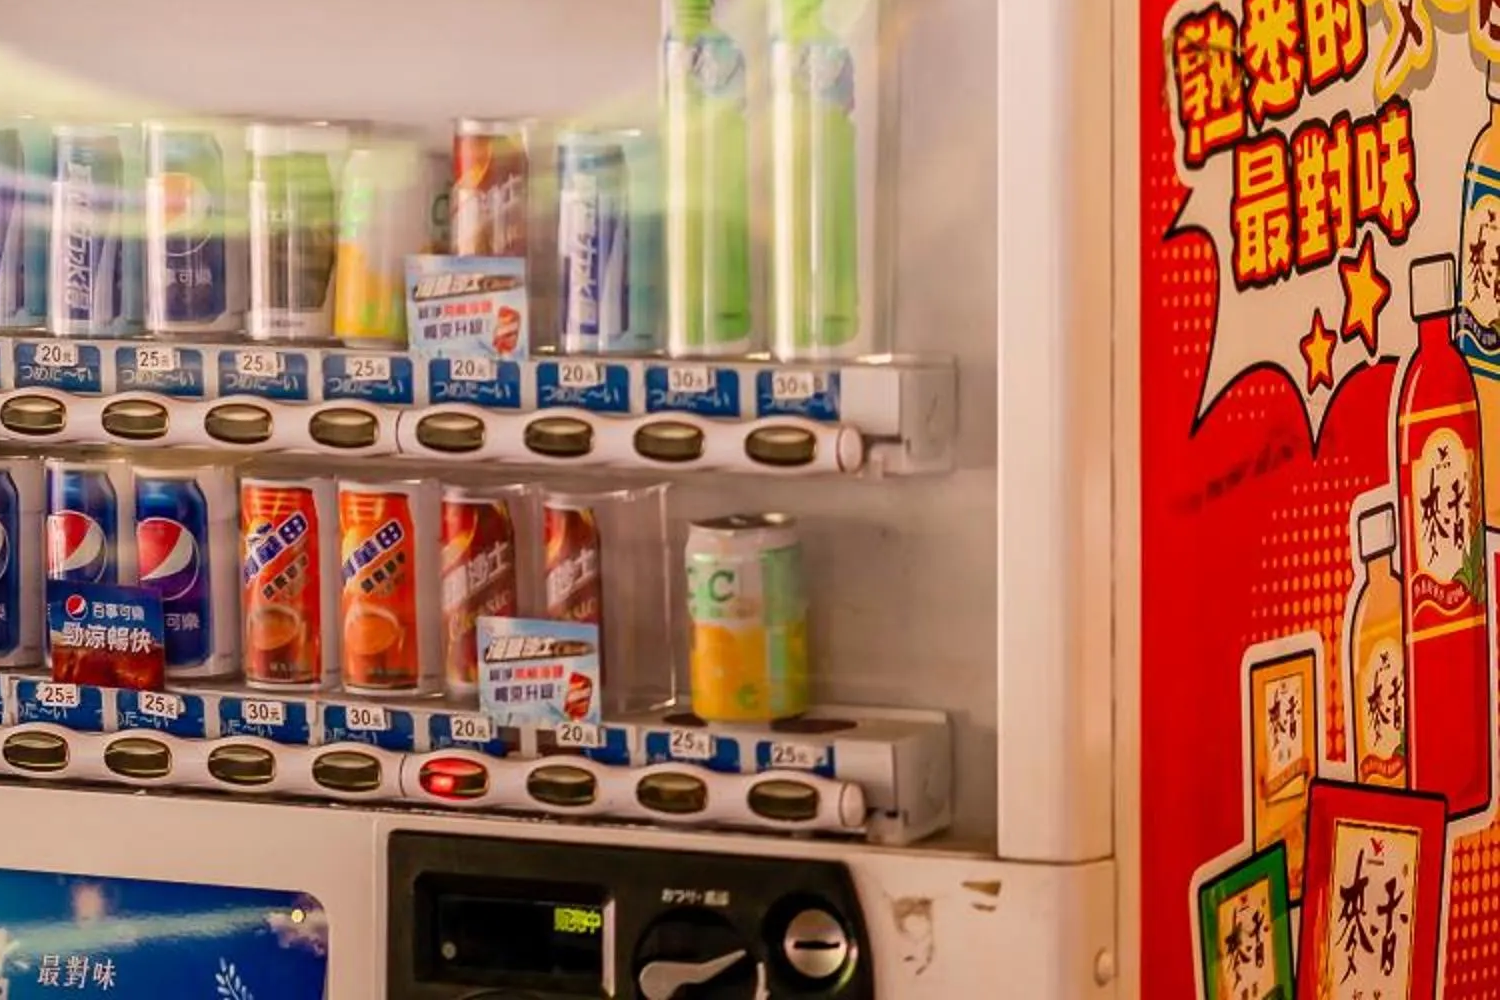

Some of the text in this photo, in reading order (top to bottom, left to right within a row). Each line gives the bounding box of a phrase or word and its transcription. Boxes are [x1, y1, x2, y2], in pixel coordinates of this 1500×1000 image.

[1233, 98, 1417, 290] 最對味
[41, 345, 72, 363] 20元
[62, 621, 152, 653] 勁涼暢快
[43, 687, 75, 704] 25元
[145, 694, 175, 716] 25元
[249, 703, 280, 720] 30元
[1337, 848, 1408, 985] 麥香
[37, 952, 117, 990] 最對味
